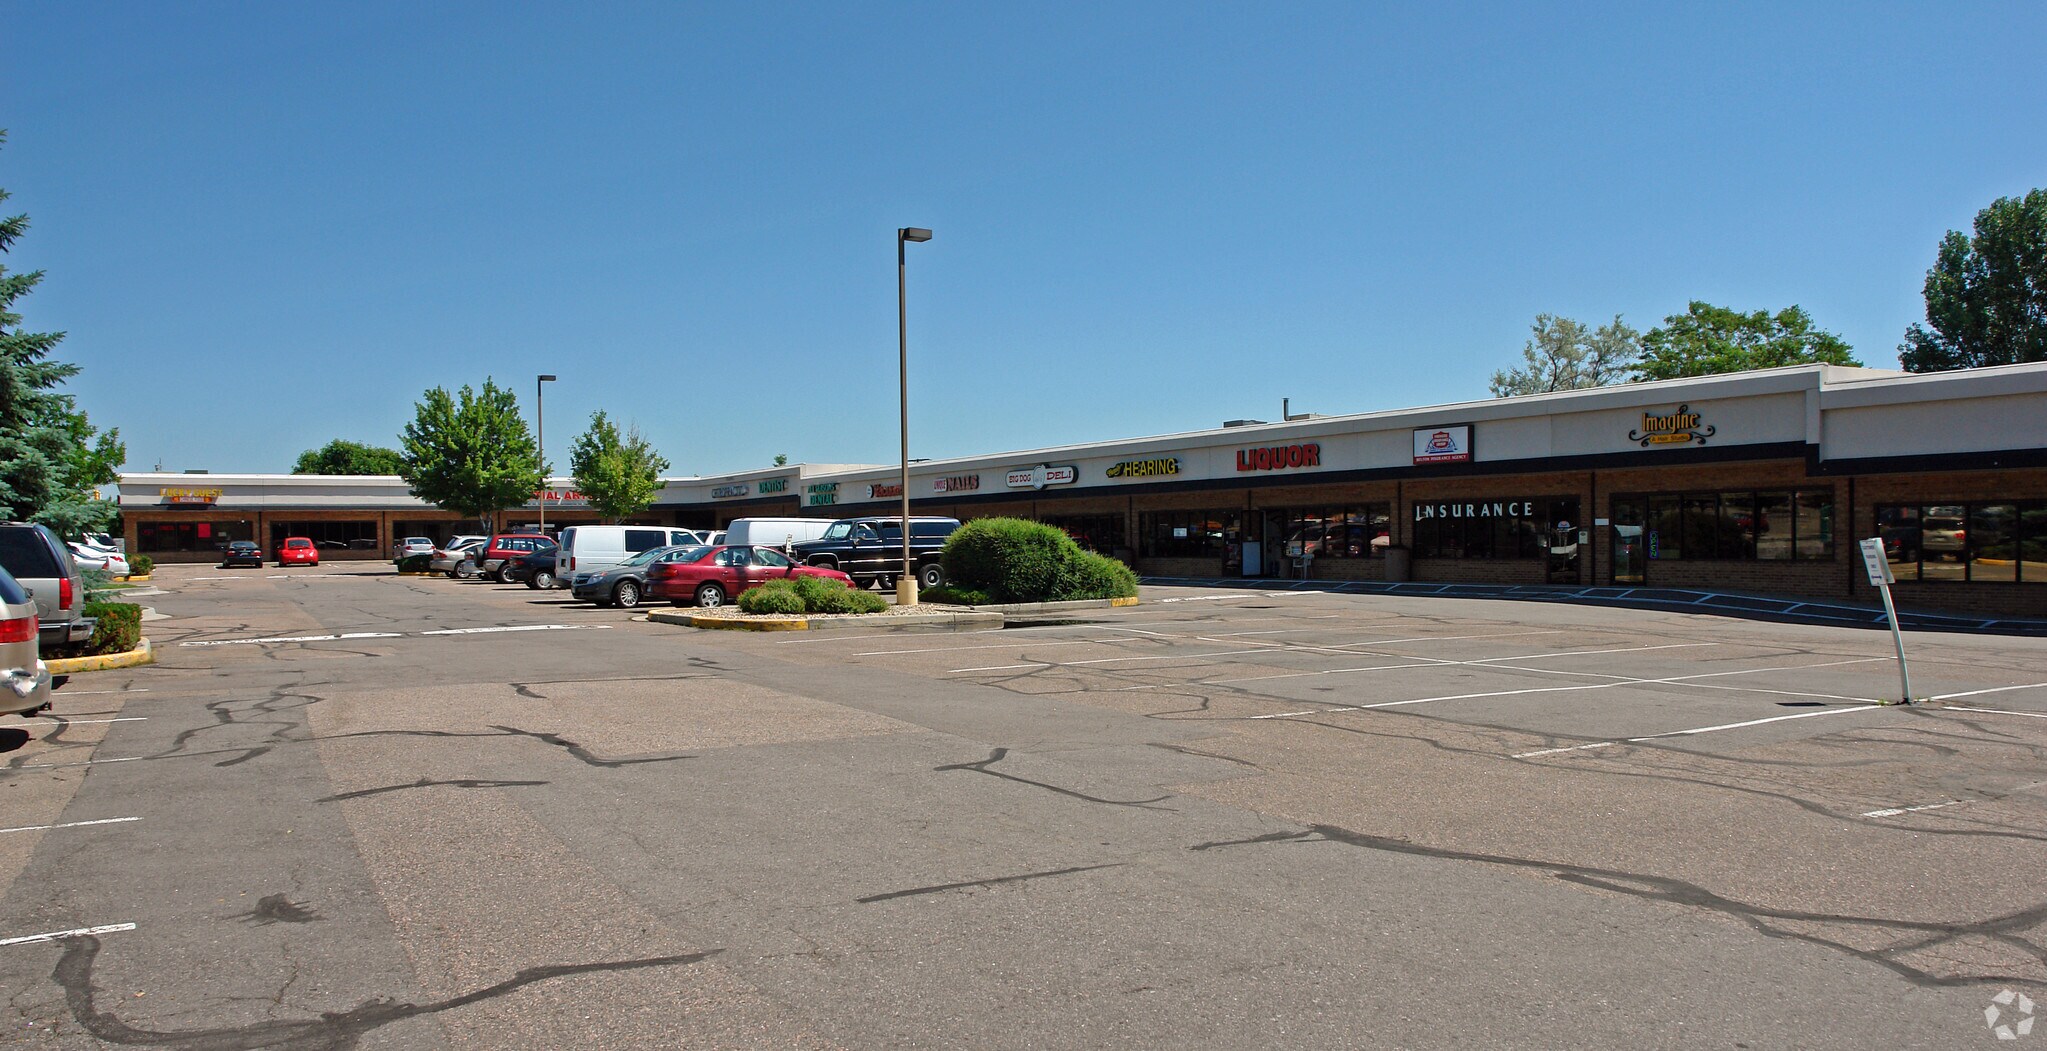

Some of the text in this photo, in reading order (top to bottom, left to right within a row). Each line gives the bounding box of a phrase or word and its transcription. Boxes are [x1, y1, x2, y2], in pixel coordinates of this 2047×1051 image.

[1642, 413, 1700, 434] Imagine
[1237, 444, 1319, 471] LIQUOR
[1009, 470, 1071, 483] BIG DOG DELI
[1125, 458, 1177, 477] HEARING
[759, 480, 785, 494] DENTIST
[947, 475, 979, 491] NAILS
[1416, 502, 1533, 521] INSURANCE
